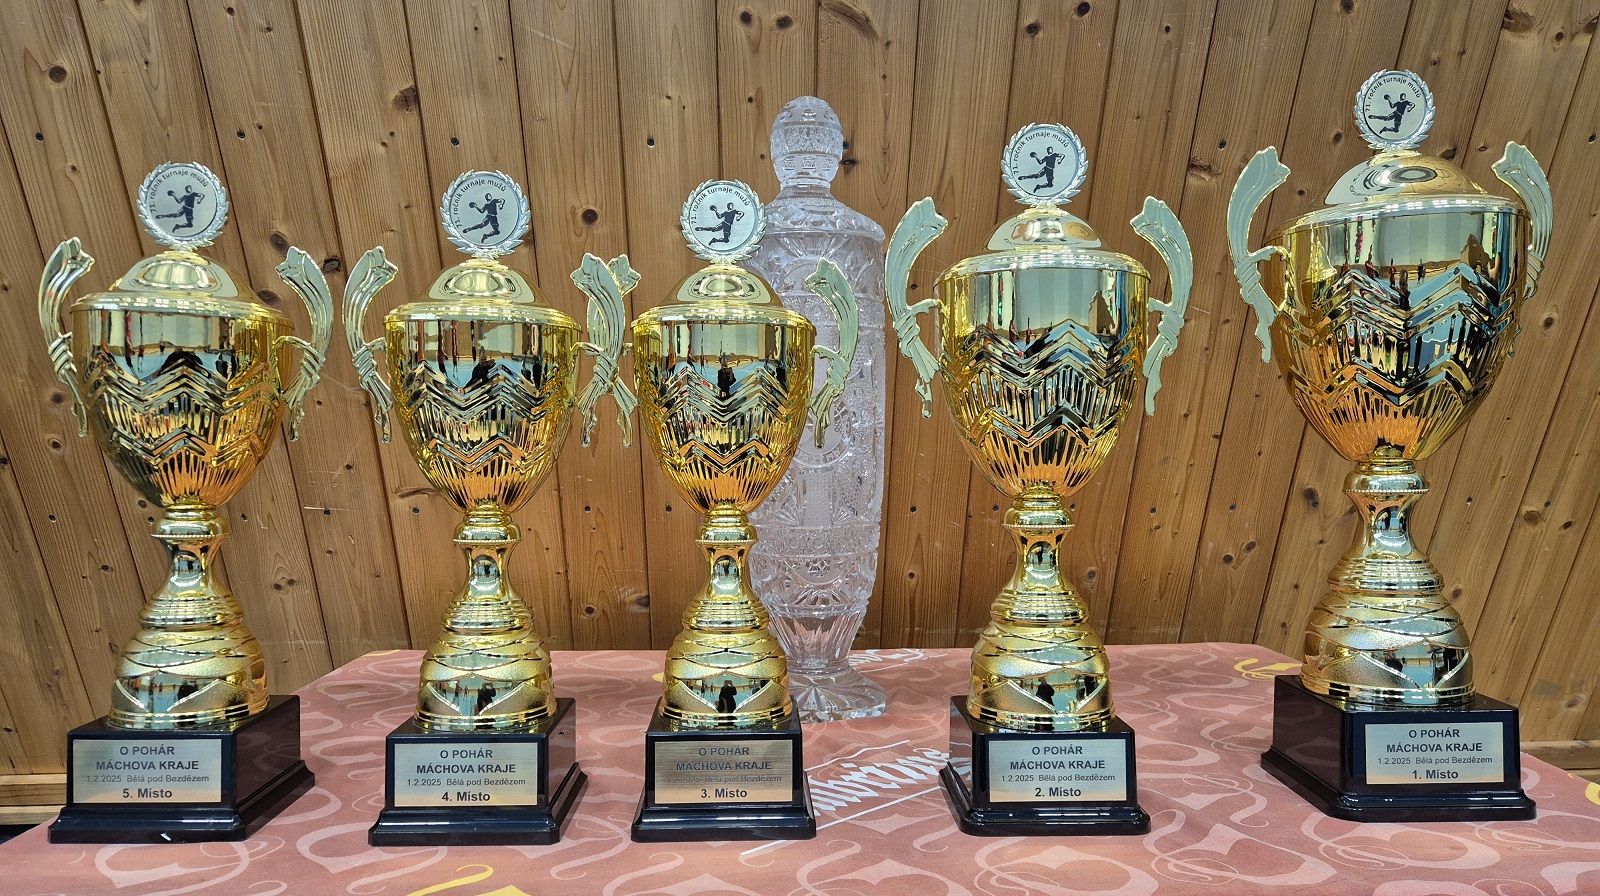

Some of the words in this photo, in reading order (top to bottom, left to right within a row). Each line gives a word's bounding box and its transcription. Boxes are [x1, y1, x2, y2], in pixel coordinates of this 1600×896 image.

[1383, 76, 1407, 85] turnaje
[1025, 130, 1051, 142] turnaje
[162, 168, 189, 180] turnaje
[460, 178, 486, 193] turnaje
[707, 186, 733, 195] turnaje
[1408, 729, 1417, 739] O
[1420, 726, 1460, 739] POHÁR
[119, 746, 129, 756] O
[132, 743, 175, 756] POHÁR
[439, 749, 449, 759] O
[452, 747, 493, 759] POHÁR
[698, 747, 707, 756] O
[710, 744, 750, 756] POHÁR
[1031, 746, 1041, 756] O
[1043, 743, 1083, 756] POHÁR
[1386, 741, 1443, 754] MÁCHOVA
[1445, 742, 1483, 752] KRAJE
[95, 758, 156, 771] MÁCHOVA
[158, 760, 200, 770] KRAJE
[676, 759, 732, 771] MÁCHOVA
[735, 760, 772, 770] KRAJE
[1010, 758, 1066, 770] MÁCHOVA
[1068, 760, 1106, 770] KRAJE
[1377, 757, 1411, 765] 1.2.2025
[1415, 756, 1433, 765] Bělá
[1434, 756, 1450, 766] pod
[1451, 756, 1493, 764] Bezdězem
[416, 762, 475, 774] MÁCHOVA
[477, 763, 516, 774] KRAJE
[1411, 770, 1422, 780] 1.
[1425, 768, 1459, 780] Místo
[86, 774, 122, 783] 1.2.2025
[126, 773, 146, 783] Bělá
[147, 774, 163, 785] pod
[165, 774, 210, 783] Bezdězem
[407, 778, 442, 787] 1.2.2025
[446, 777, 465, 786] Bělá
[466, 778, 482, 788] pod
[483, 777, 526, 786] Bezdězem
[1001, 774, 1035, 783] 1.2.2025
[1038, 773, 1056, 782] Bělá
[1057, 774, 1073, 783] pod
[1074, 773, 1116, 782] Bezdězem
[122, 788, 133, 799] 5.
[137, 787, 173, 799] Místo
[441, 791, 453, 802] 4.
[456, 791, 491, 802] Místo
[700, 788, 711, 799] 3.
[714, 787, 748, 799] Místo
[1034, 787, 1045, 798] 2.
[1048, 786, 1082, 797] Místo
